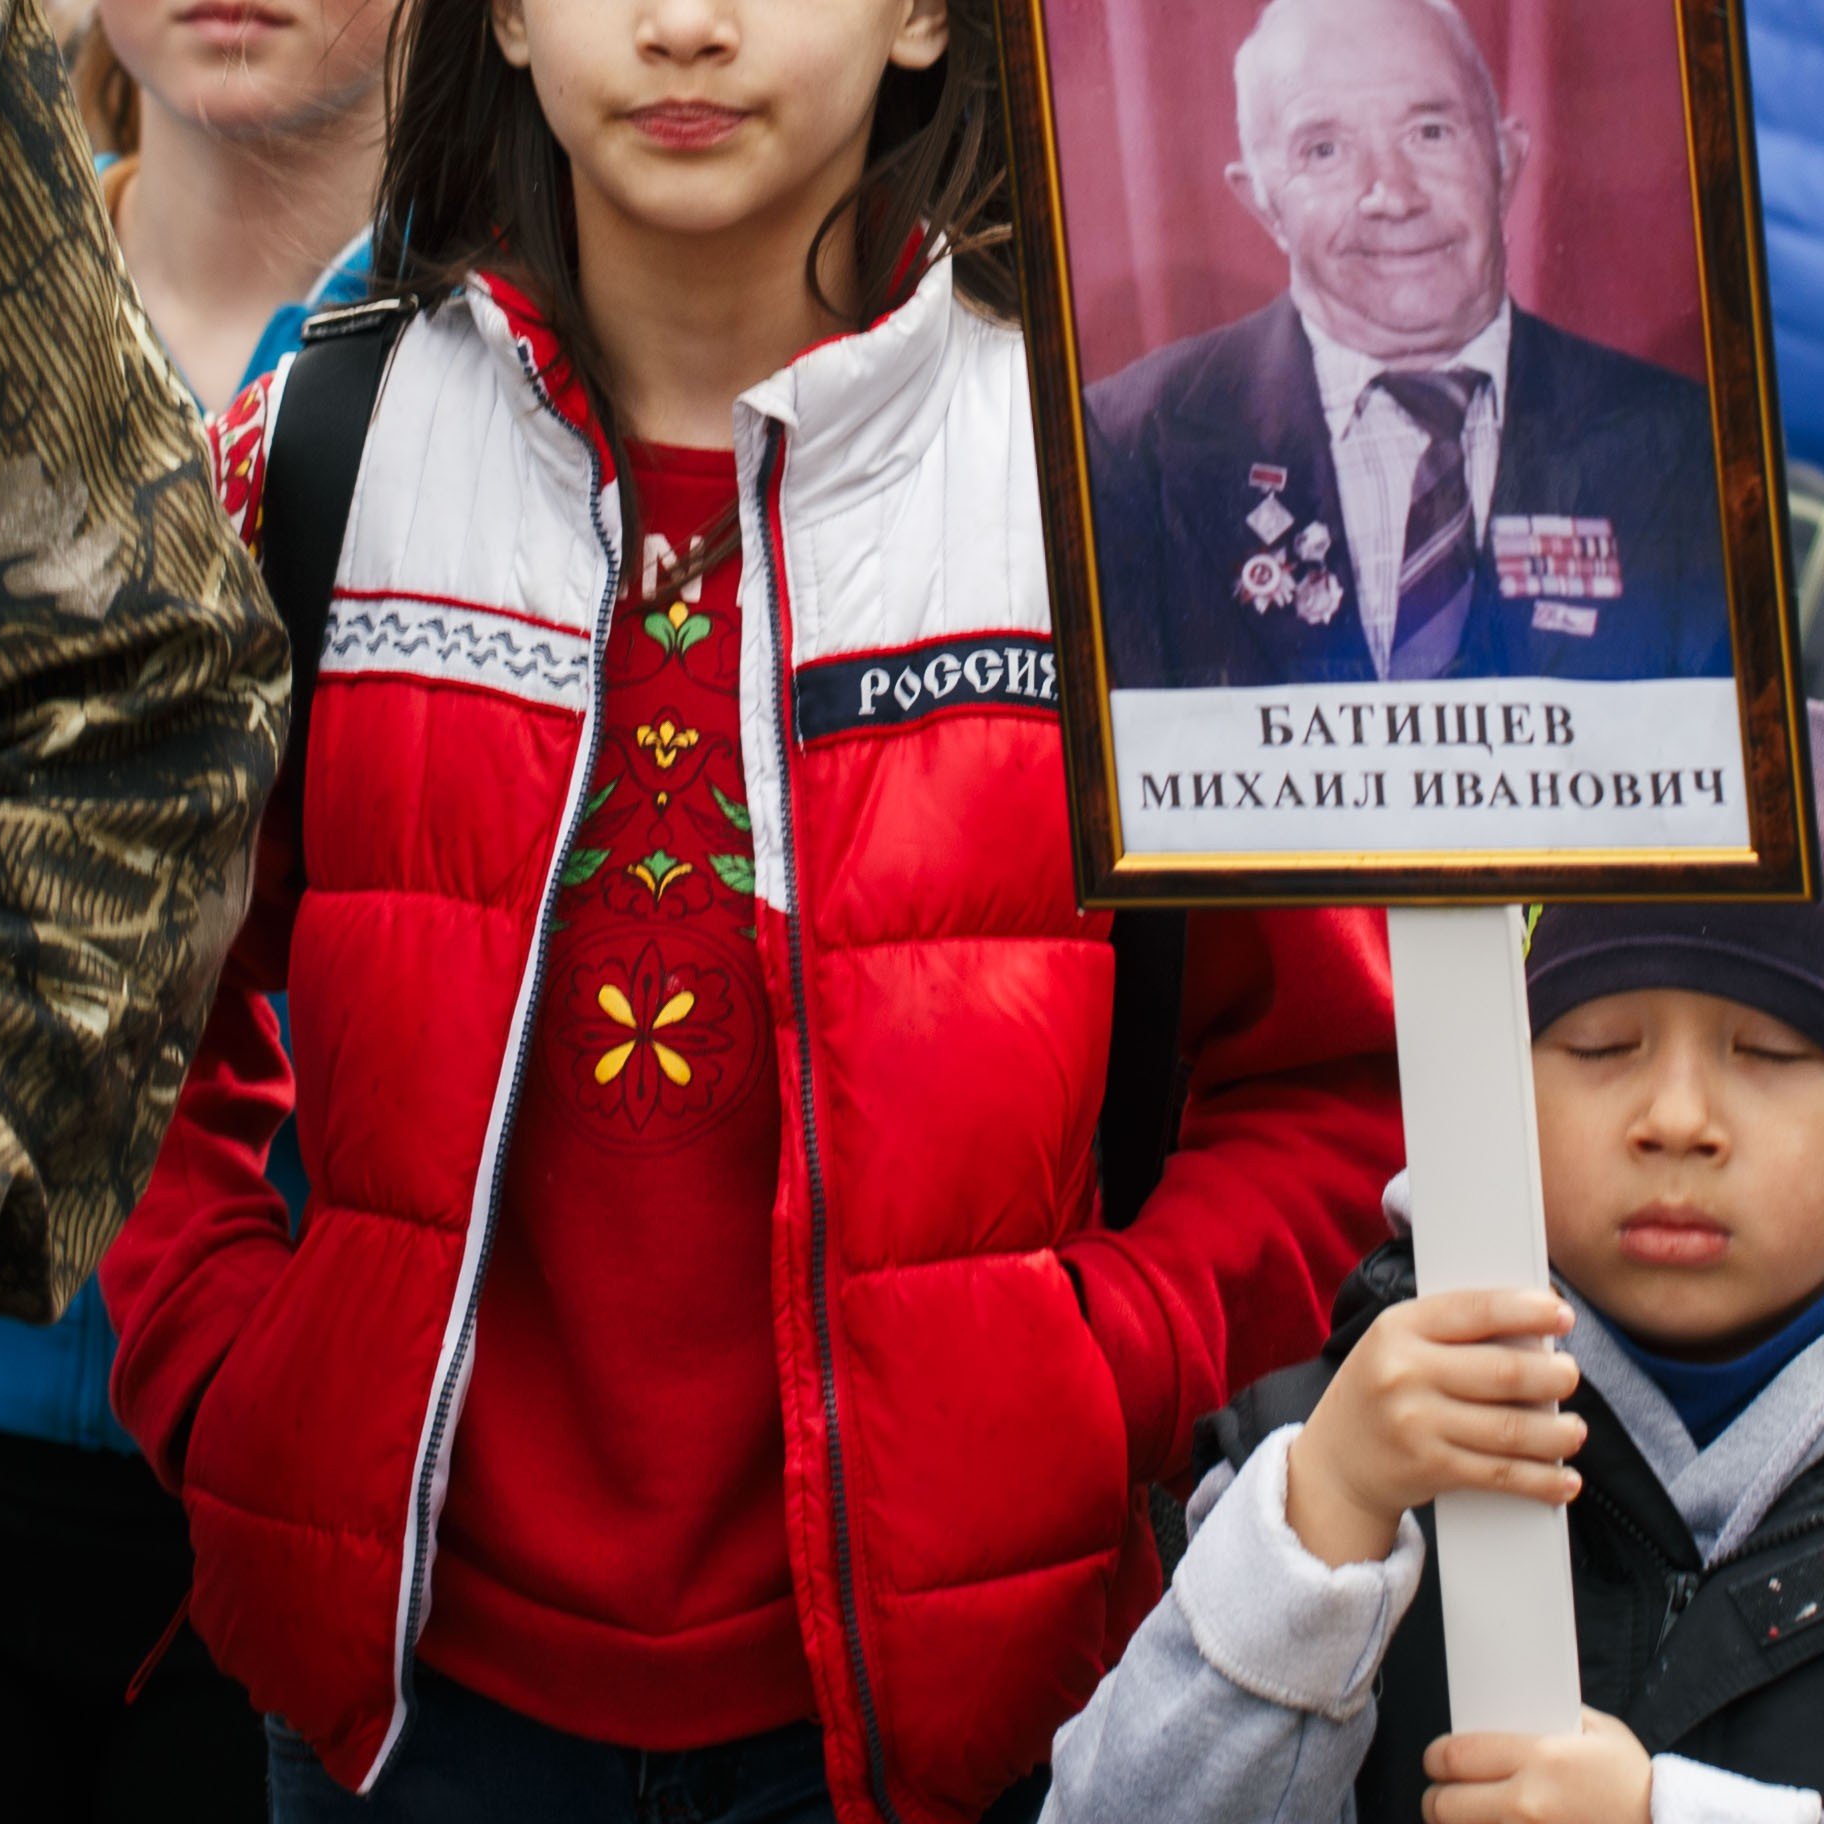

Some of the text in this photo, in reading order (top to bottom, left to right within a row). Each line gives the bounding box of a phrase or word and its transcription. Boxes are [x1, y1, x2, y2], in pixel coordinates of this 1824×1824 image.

[1257, 702, 1577, 755] БАТИЩЕВ
[1140, 767, 1727, 810] МИХАИЛ ИВАНОВИЧ
